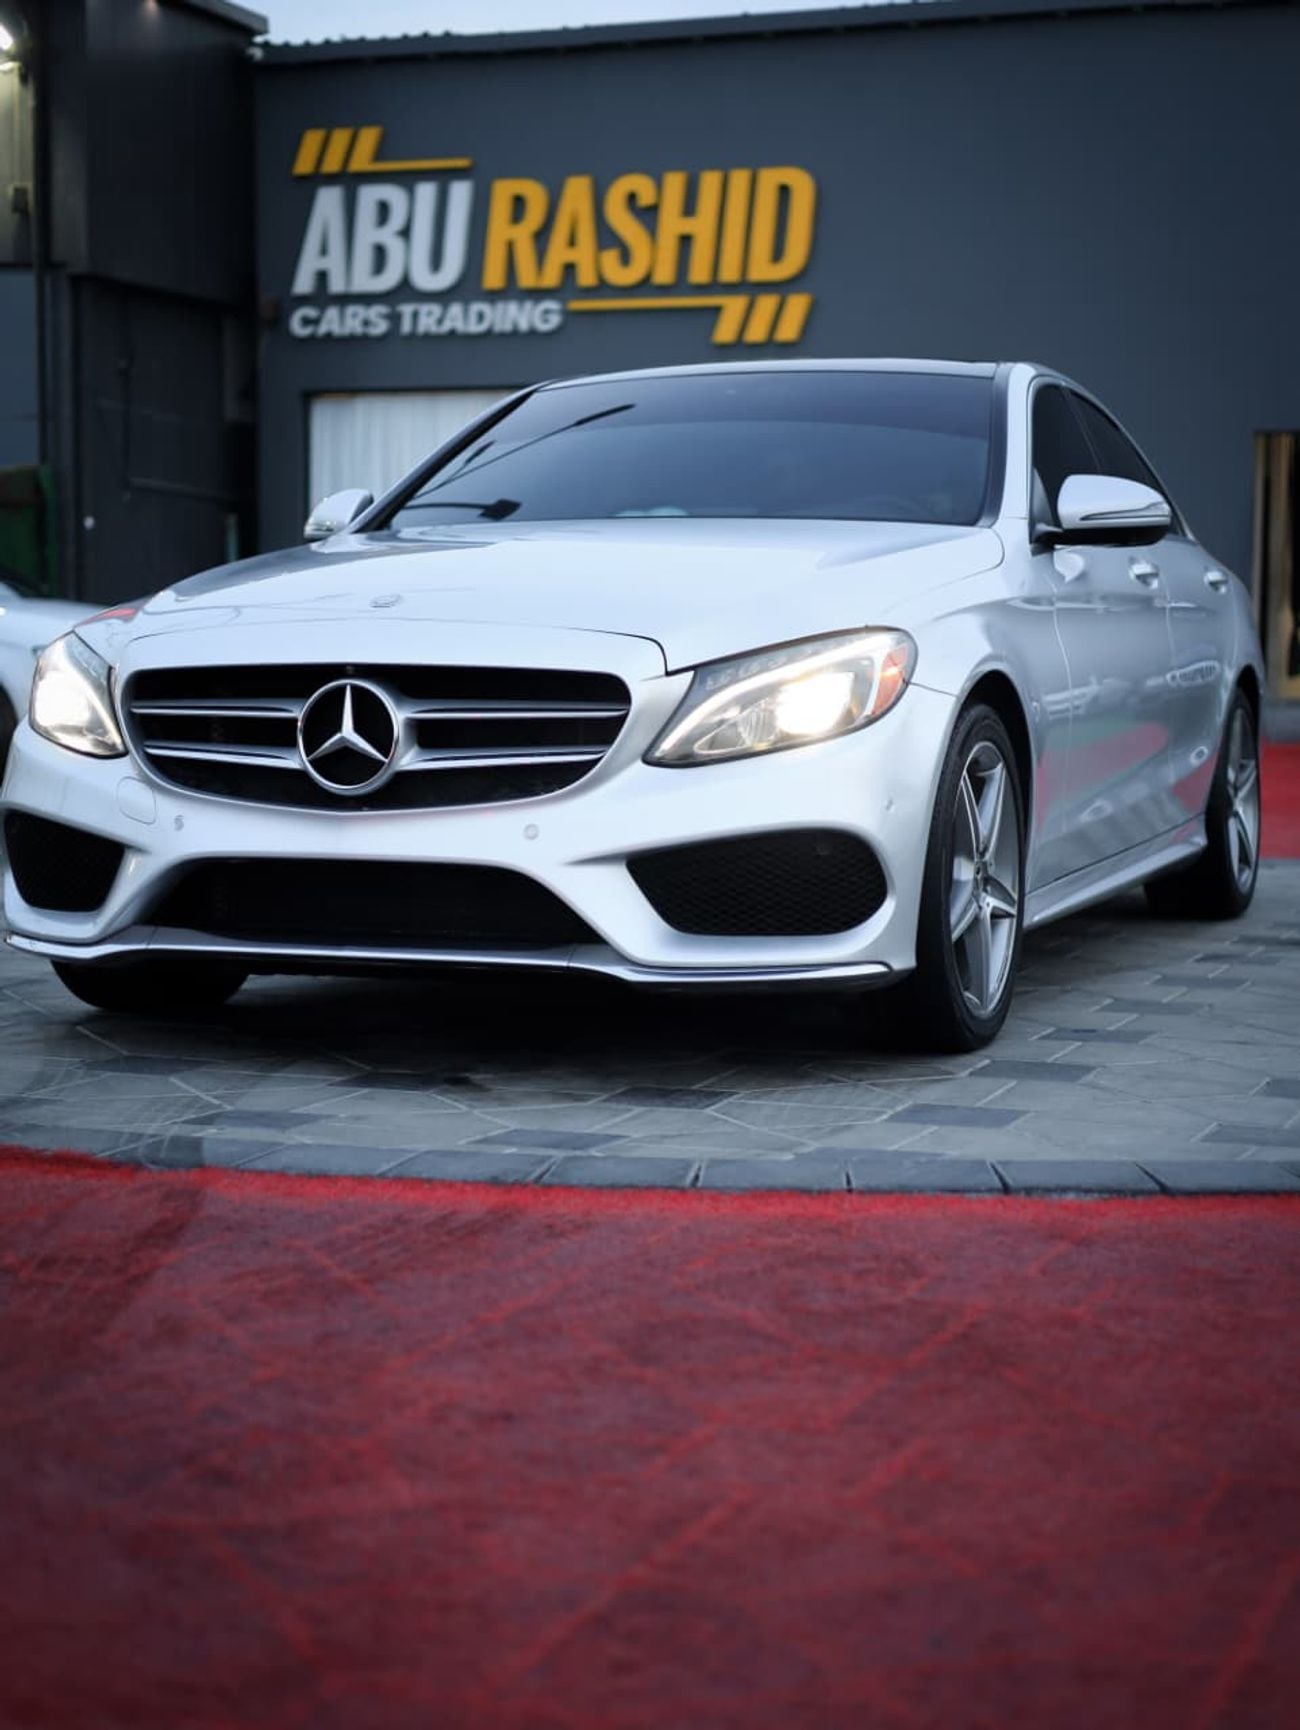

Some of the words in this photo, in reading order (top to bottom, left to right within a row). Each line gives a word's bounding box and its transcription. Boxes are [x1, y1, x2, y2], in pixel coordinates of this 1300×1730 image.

[291, 180, 474, 295] ABU
[482, 166, 817, 291] RASHID
[290, 304, 390, 337] CARS
[397, 299, 564, 336] TRADING
